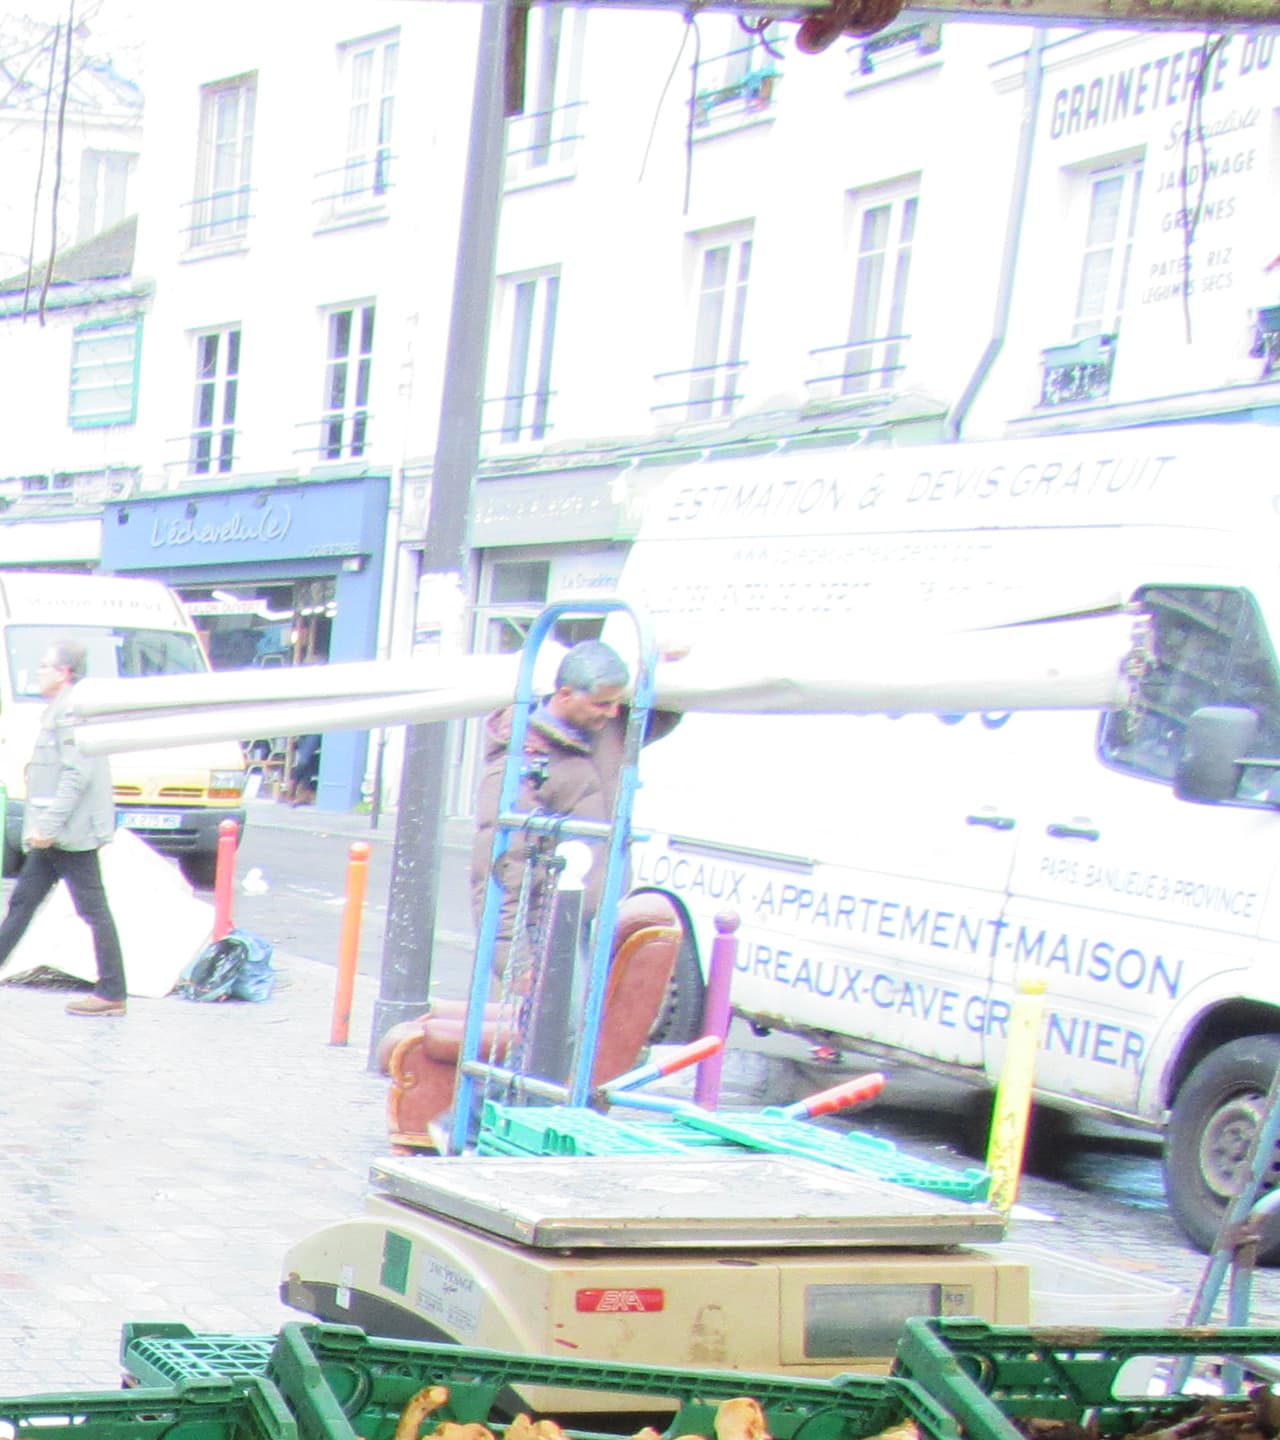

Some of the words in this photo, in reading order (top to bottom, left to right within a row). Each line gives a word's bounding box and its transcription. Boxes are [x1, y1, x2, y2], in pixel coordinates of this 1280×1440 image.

[1155, 148, 1257, 193] JADNAGE
[667, 476, 845, 523] ESTIMATION
[858, 472, 886, 511] &
[906, 465, 1005, 505] DEVIS
[1008, 455, 1178, 498] GRATUIT
[637, 850, 744, 905] LOCAUX
[1083, 864, 1158, 901] BANLIEUE
[1171, 878, 1260, 920] PROVINCE
[735, 941, 959, 1029] UREAUX-CAVE
[963, 993, 1147, 1075] GRNIER
